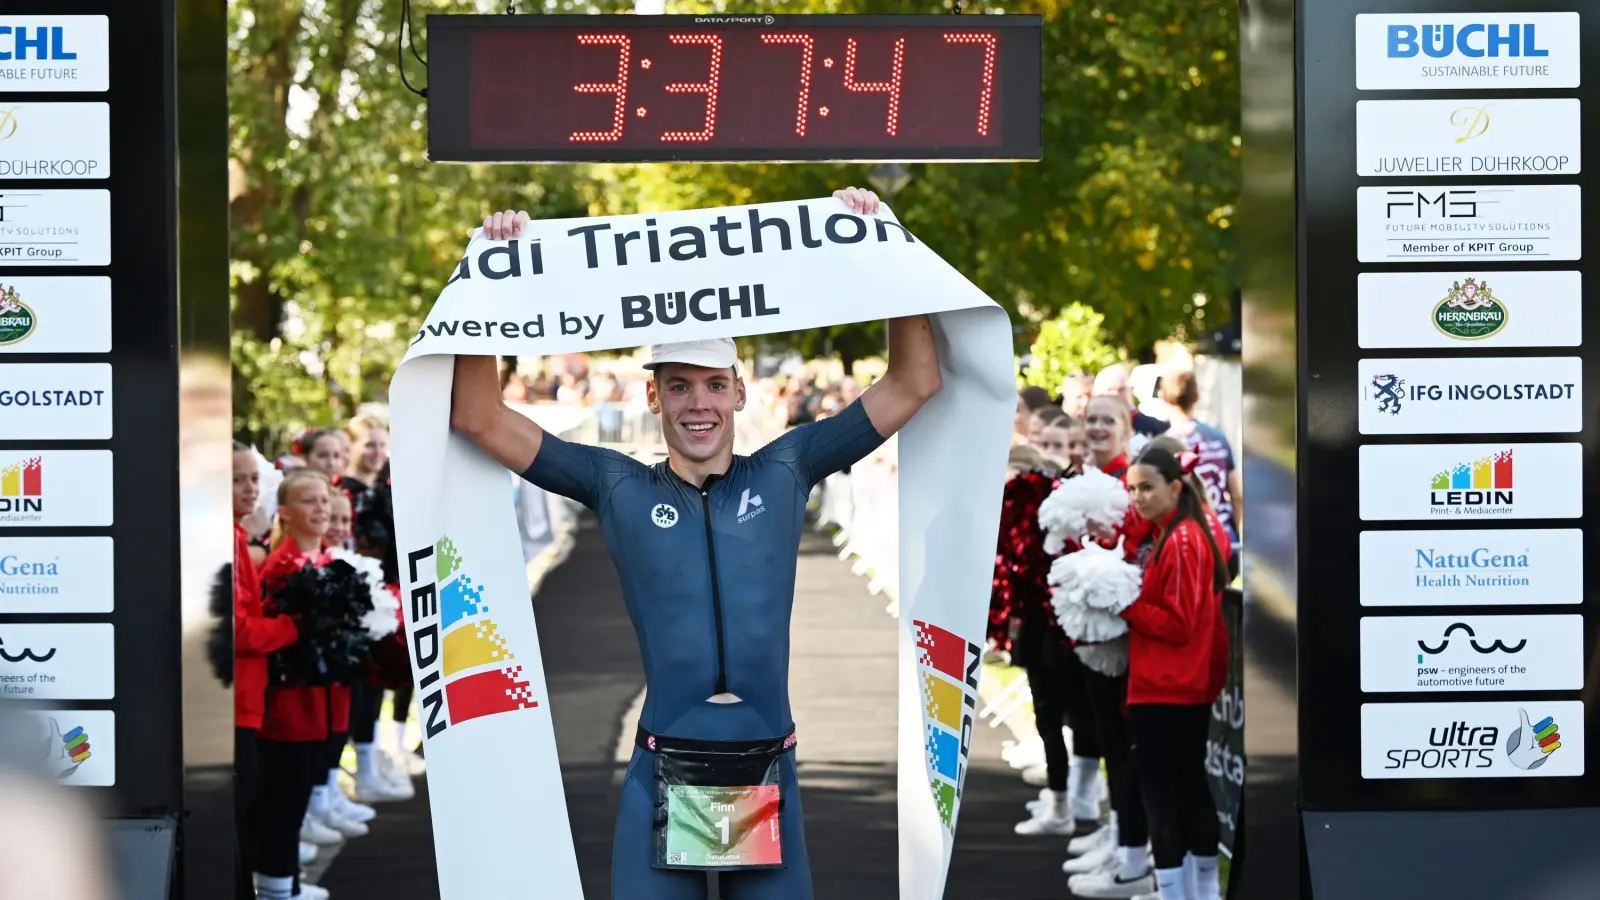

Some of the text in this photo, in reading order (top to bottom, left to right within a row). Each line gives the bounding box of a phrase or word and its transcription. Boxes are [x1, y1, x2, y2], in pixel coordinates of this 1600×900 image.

[1387, 23, 1549, 58] BÜCHL
[31, 69, 78, 79] FUTURE
[1422, 65, 1549, 77] SUSTAINABLE FUTURE
[0, 160, 98, 175] DÜHRKOOP
[1374, 155, 1569, 173] JUWELIER DÜHRKOOP
[1387, 190, 1476, 218] FMS
[16, 227, 80, 235] SOLUTIONS
[1386, 222, 1551, 232] FUTURE MOBILITY SOLUTIONS
[567, 205, 915, 269] Triathlon
[27, 247, 62, 258] Group
[1403, 243, 1534, 254] Member of KPIT Group
[559, 311, 605, 340] by
[621, 284, 780, 329] BÜCHL
[1438, 311, 1502, 321] HERRNBRÄU
[0, 391, 104, 406] GOLSTADT
[1410, 384, 1575, 400] IFG INGOLSTADT
[1431, 491, 1513, 505] LEDIN
[738, 505, 766, 524] surpas
[1430, 506, 1513, 515] Print- & Mediacenter
[1415, 548, 1529, 568] NatuGena
[0, 555, 58, 576] Gena
[1416, 574, 1529, 587] Health Nutrition
[408, 545, 447, 740] LEDIN
[27, 672, 37, 683] of
[40, 673, 56, 683] the
[1417, 667, 1439, 677] psw
[1448, 666, 1496, 676] engineers
[1498, 665, 1509, 674] of
[1510, 665, 1526, 674] the
[1417, 677, 1505, 686] automotive future
[4, 685, 34, 695] future
[1428, 722, 1499, 746] ultra
[1385, 749, 1494, 769] SPORTS
[710, 802, 735, 812] Finn
[715, 816, 730, 845] 1
